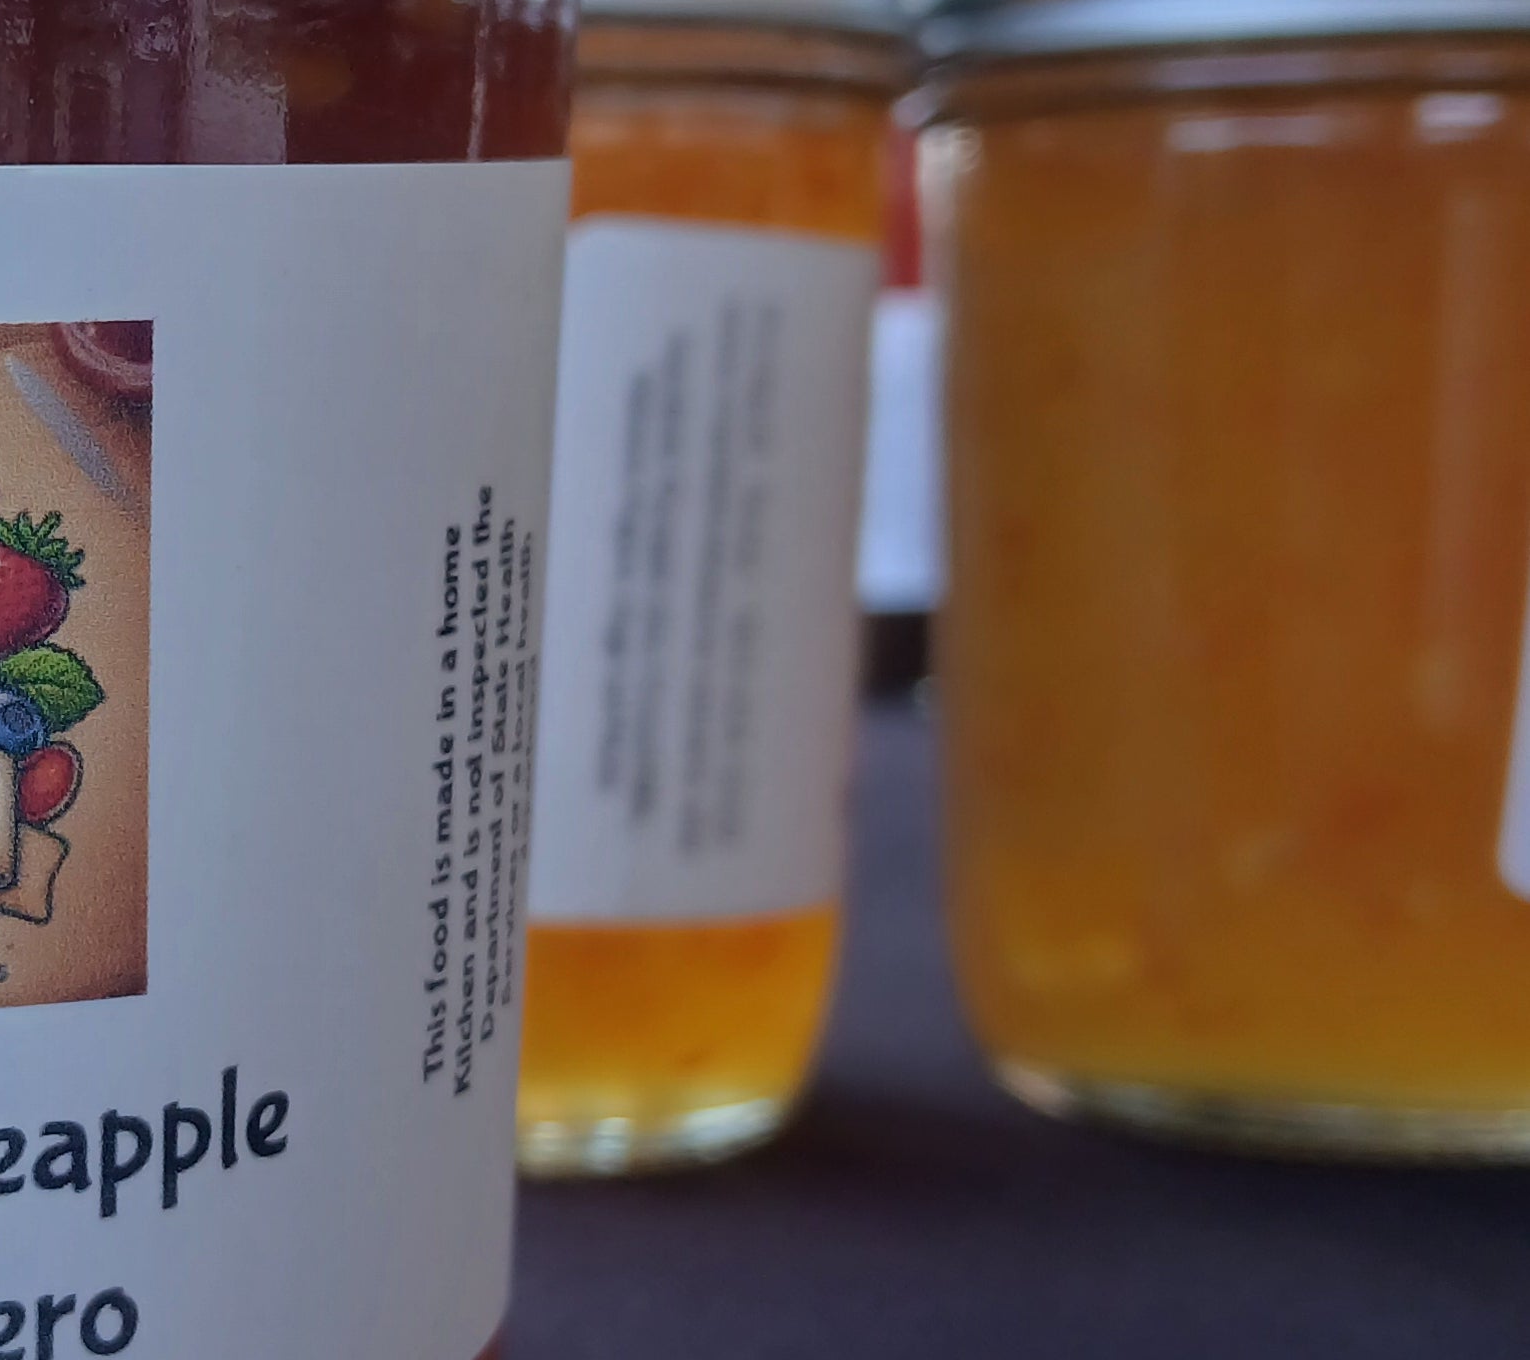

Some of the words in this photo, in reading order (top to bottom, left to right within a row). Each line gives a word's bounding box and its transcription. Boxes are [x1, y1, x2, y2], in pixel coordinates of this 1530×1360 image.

[471, 485, 492, 547] the
[436, 524, 460, 638] home
[494, 517, 515, 649] Health
[441, 649, 458, 672] a
[467, 559, 489, 742] inspected
[436, 686, 457, 721] in
[491, 660, 509, 755] State
[431, 735, 454, 843] made
[465, 753, 483, 815] not
[489, 770, 505, 808] of
[430, 854, 451, 886] is
[463, 829, 480, 858] is
[424, 898, 449, 993] food
[460, 868, 478, 940] and
[479, 819, 503, 1043] Department
[422, 1000, 447, 1083] This
[453, 953, 475, 1097] Kitchen
